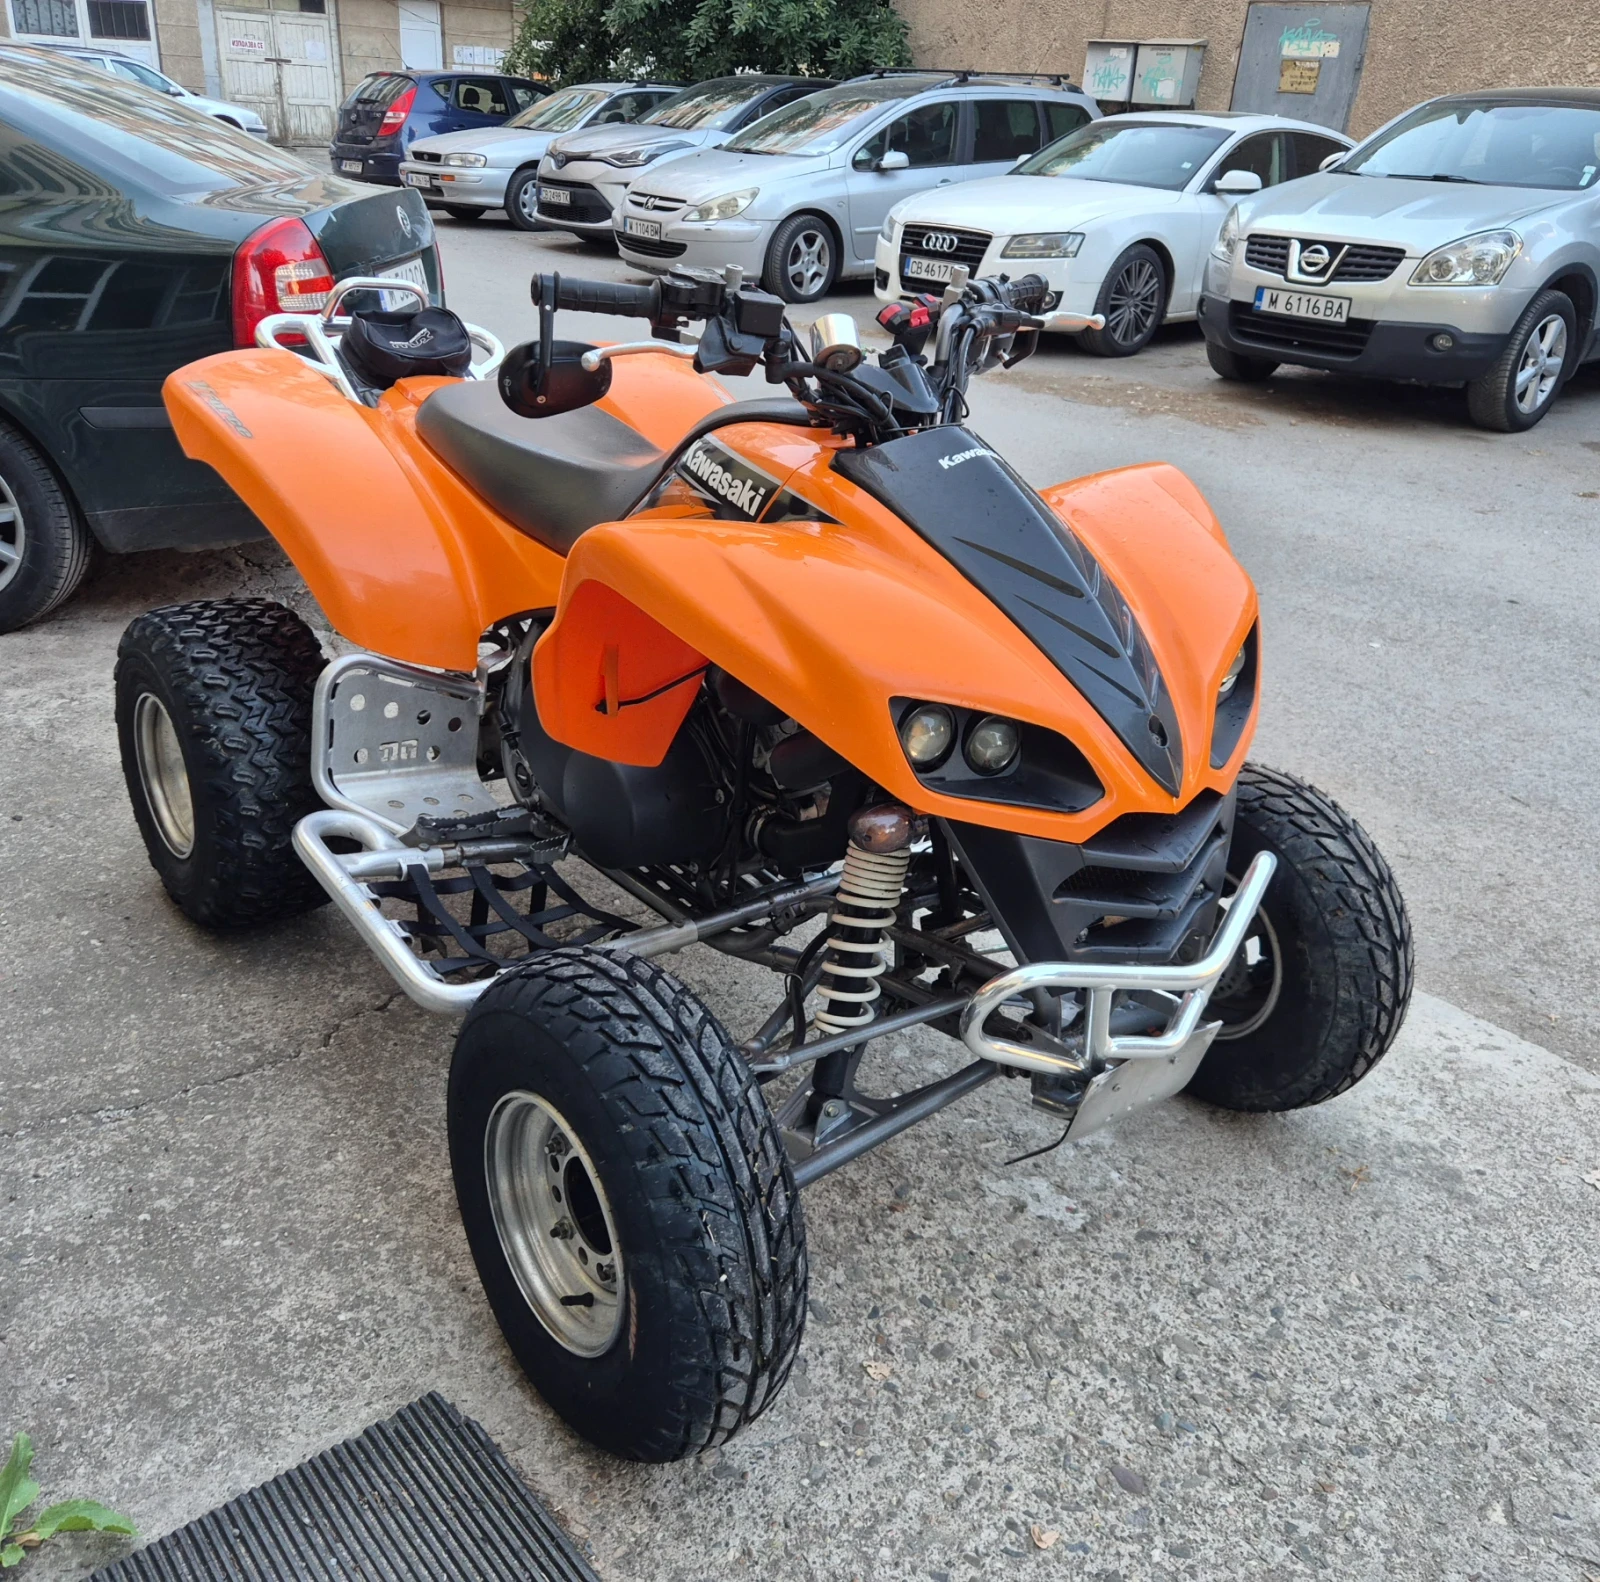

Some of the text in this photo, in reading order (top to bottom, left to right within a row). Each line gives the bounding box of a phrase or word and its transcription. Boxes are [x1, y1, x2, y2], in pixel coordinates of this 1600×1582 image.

[910, 260, 923, 275] CB
[924, 263, 949, 279] 4617
[1268, 291, 1280, 310] M
[683, 438, 766, 517] Kawasaki
